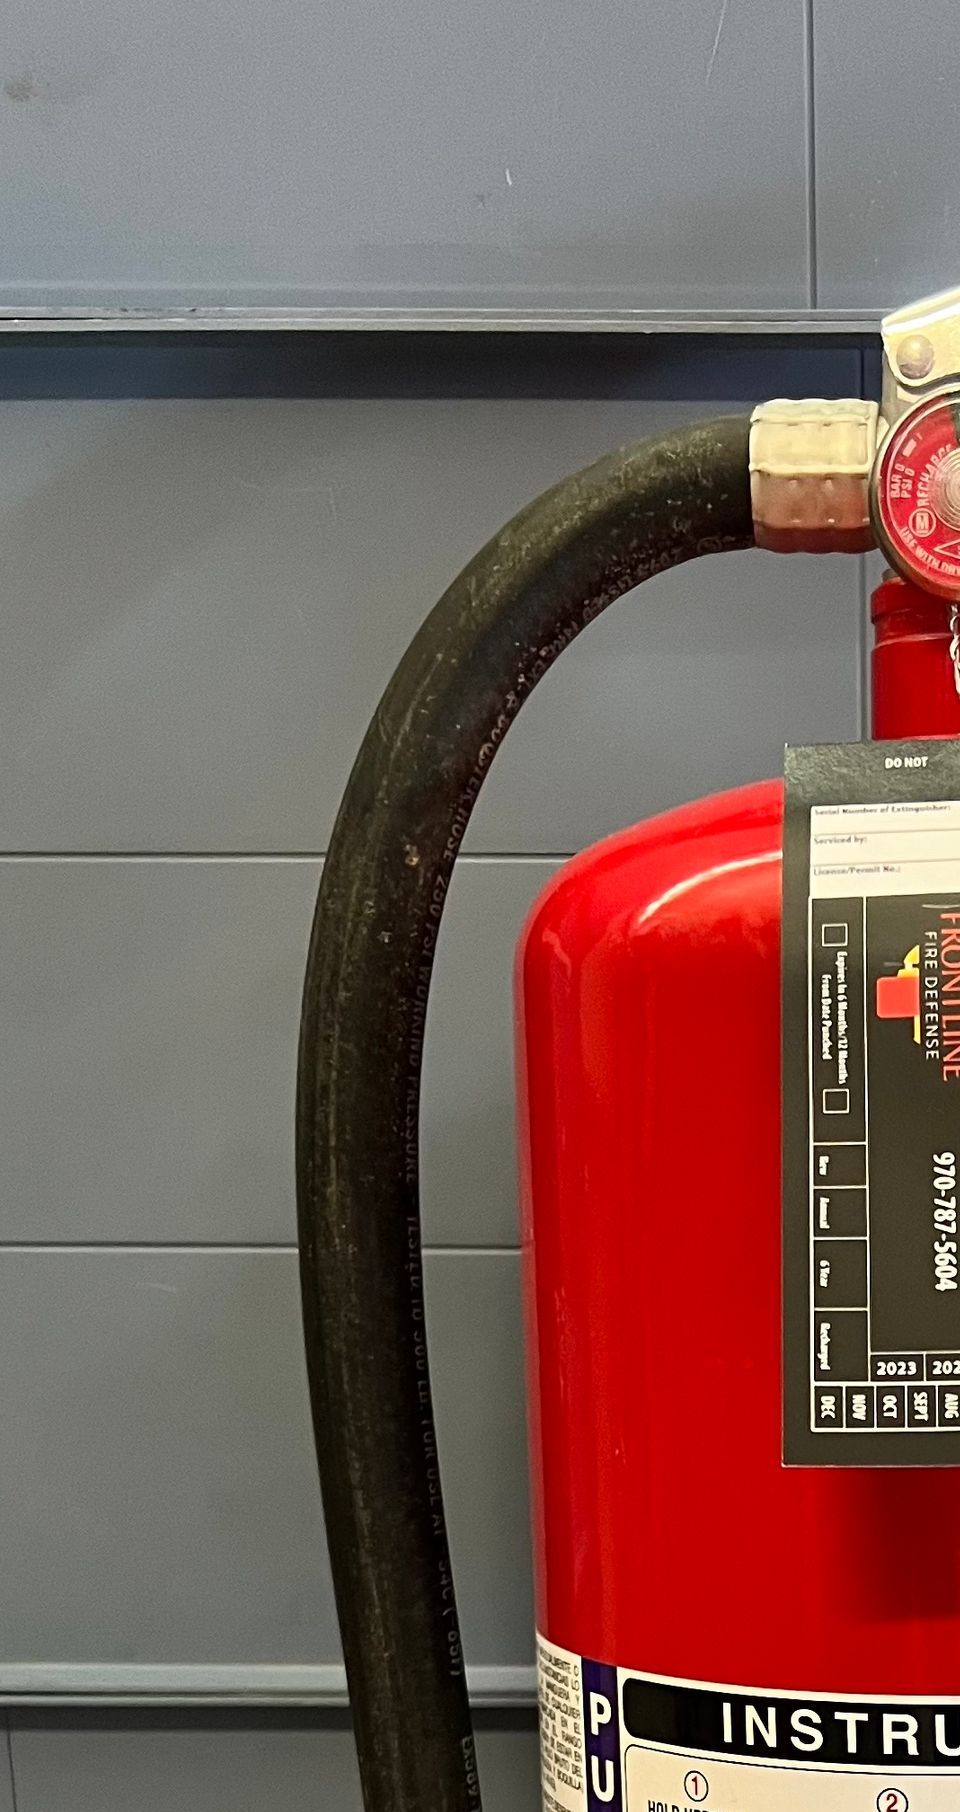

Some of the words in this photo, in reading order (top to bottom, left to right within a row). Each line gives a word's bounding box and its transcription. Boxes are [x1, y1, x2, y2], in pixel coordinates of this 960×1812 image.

[885, 756, 902, 768] DO
[904, 756, 928, 768] NOT
[924, 931, 938, 970] FIRE
[924, 977, 939, 1060] DEFENSE
[932, 1152, 958, 1291] 970-787-5604
[876, 1361, 917, 1376] 2023
[821, 1395, 835, 1419] DEC
[852, 1394, 867, 1420] NOV
[883, 1394, 897, 1419] OCT
[914, 1392, 928, 1421] SEPT
[944, 1393, 959, 1419] AUG
